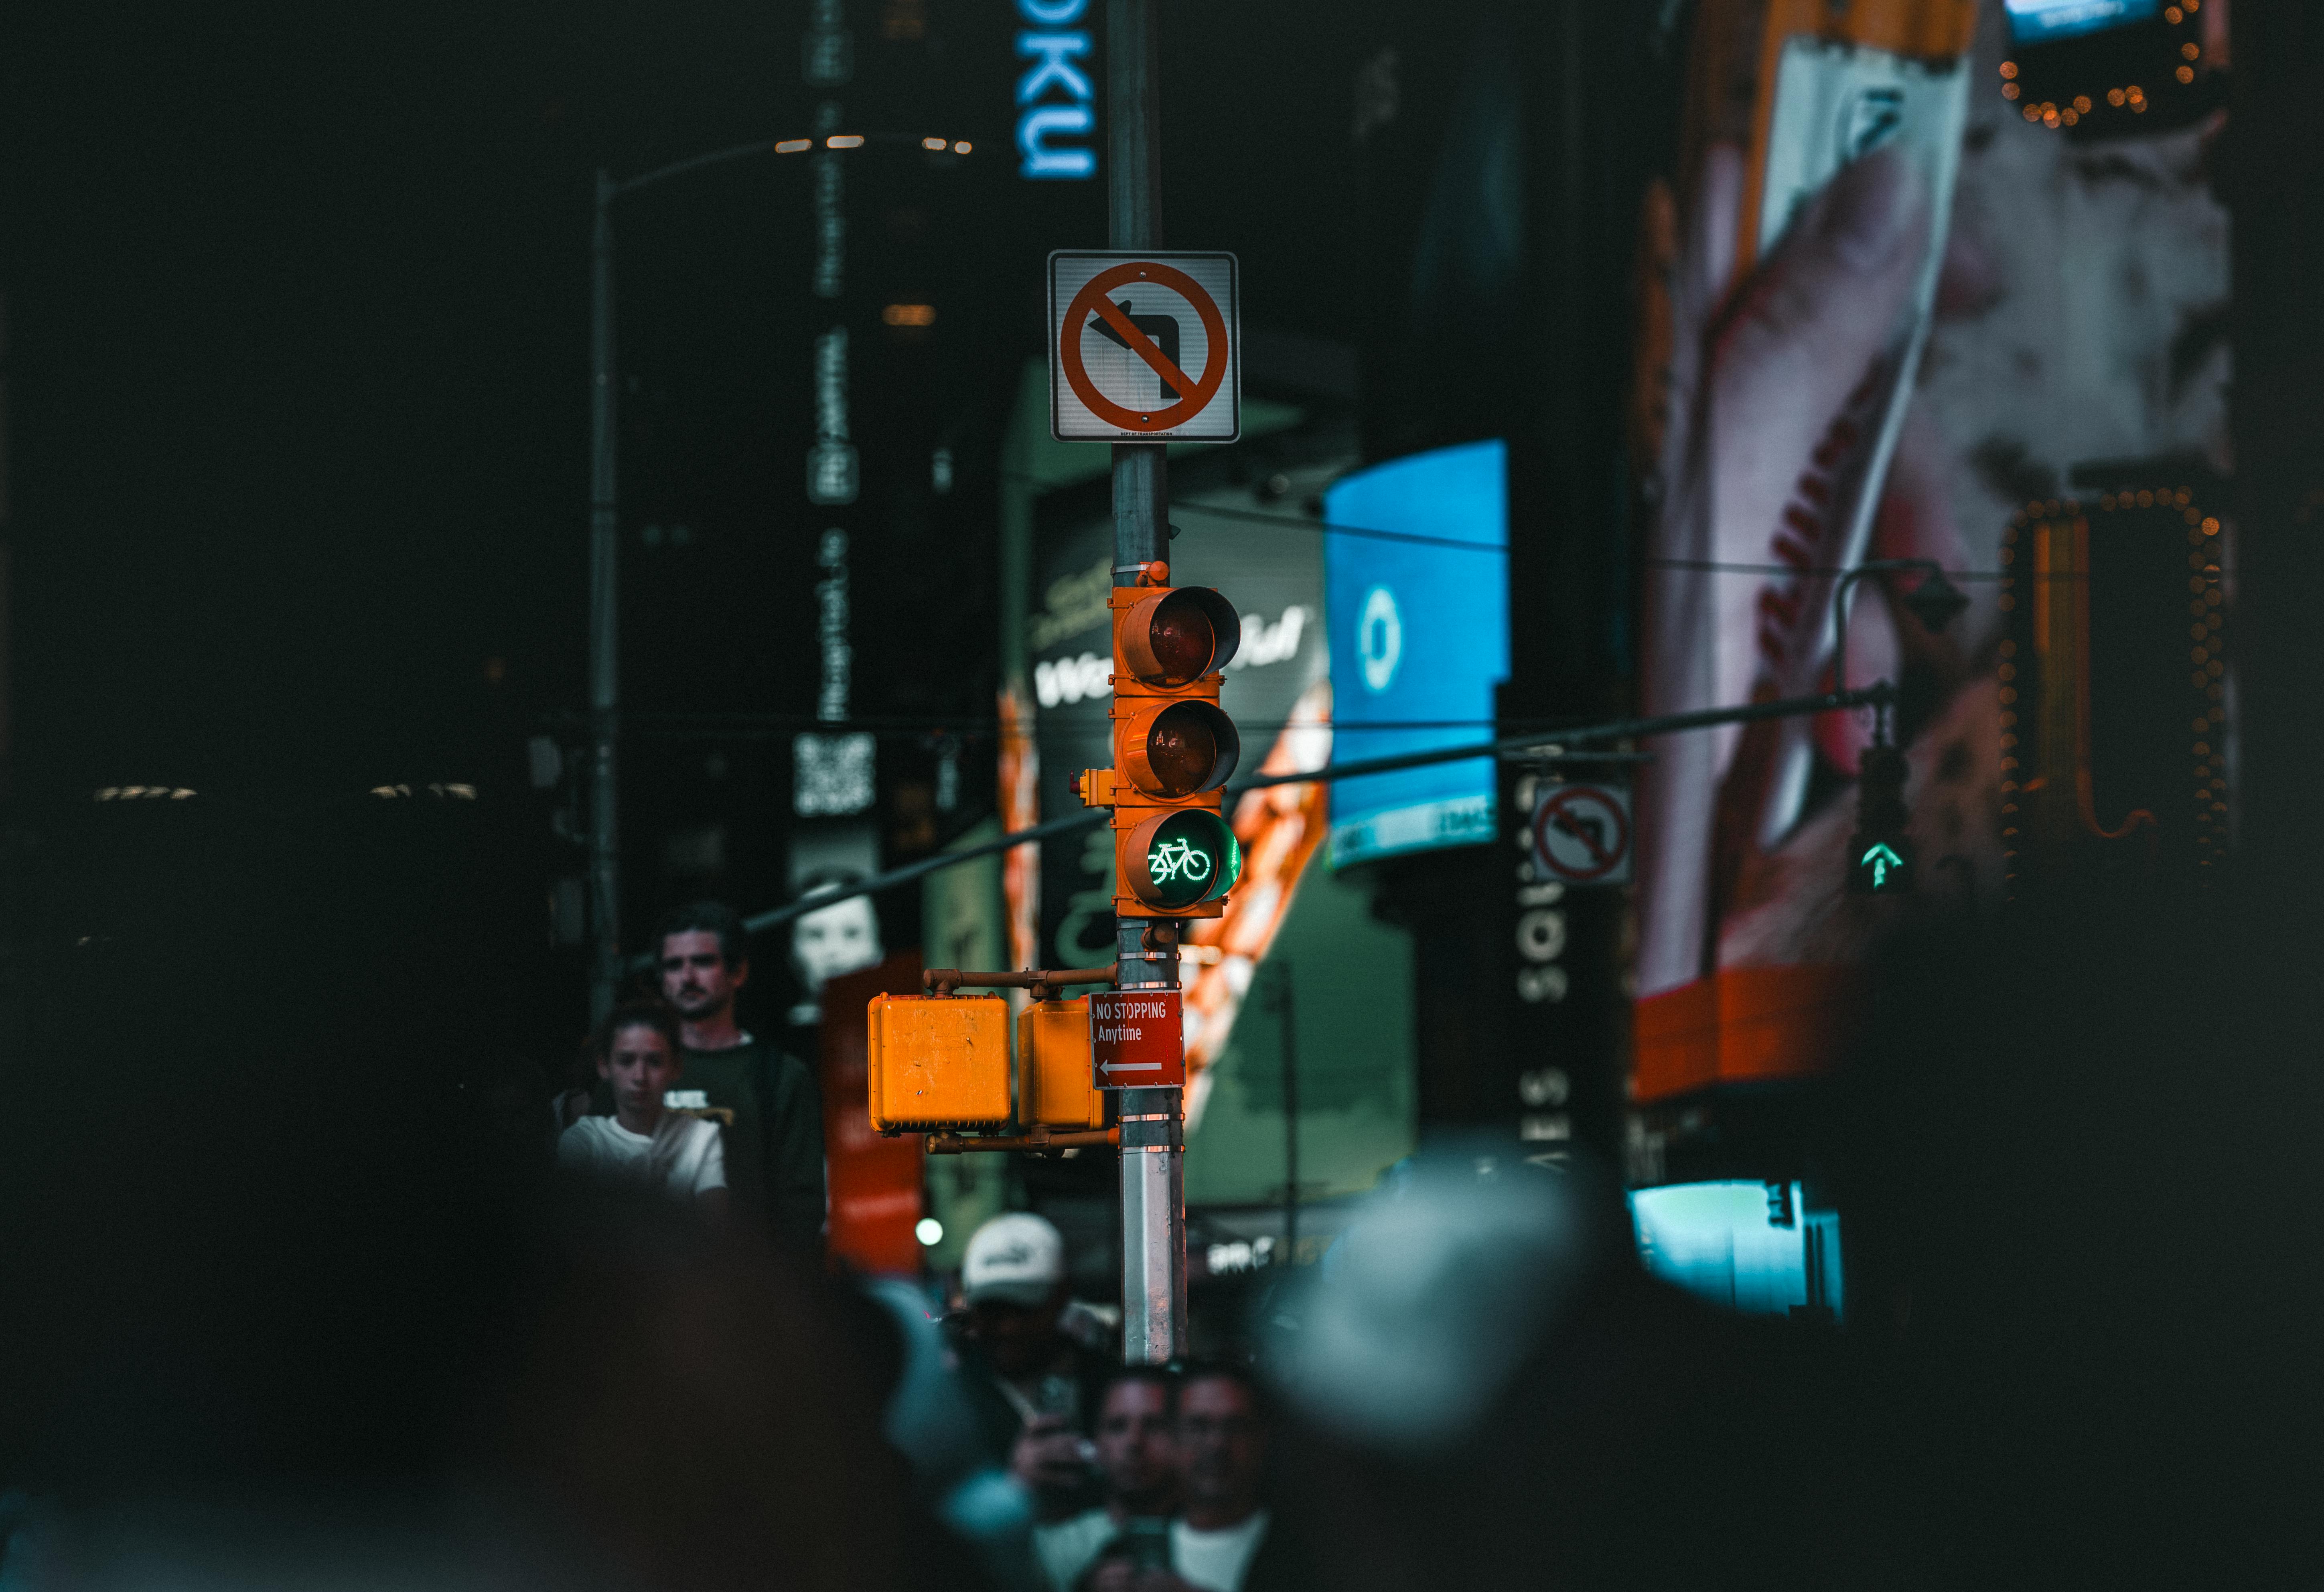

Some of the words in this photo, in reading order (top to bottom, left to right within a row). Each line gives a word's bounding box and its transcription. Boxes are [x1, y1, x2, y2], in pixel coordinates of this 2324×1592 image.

[1097, 1003, 1111, 1020] NO
[1114, 1002, 1166, 1019] STOPPING
[1098, 1024, 1142, 1045] Anytime
